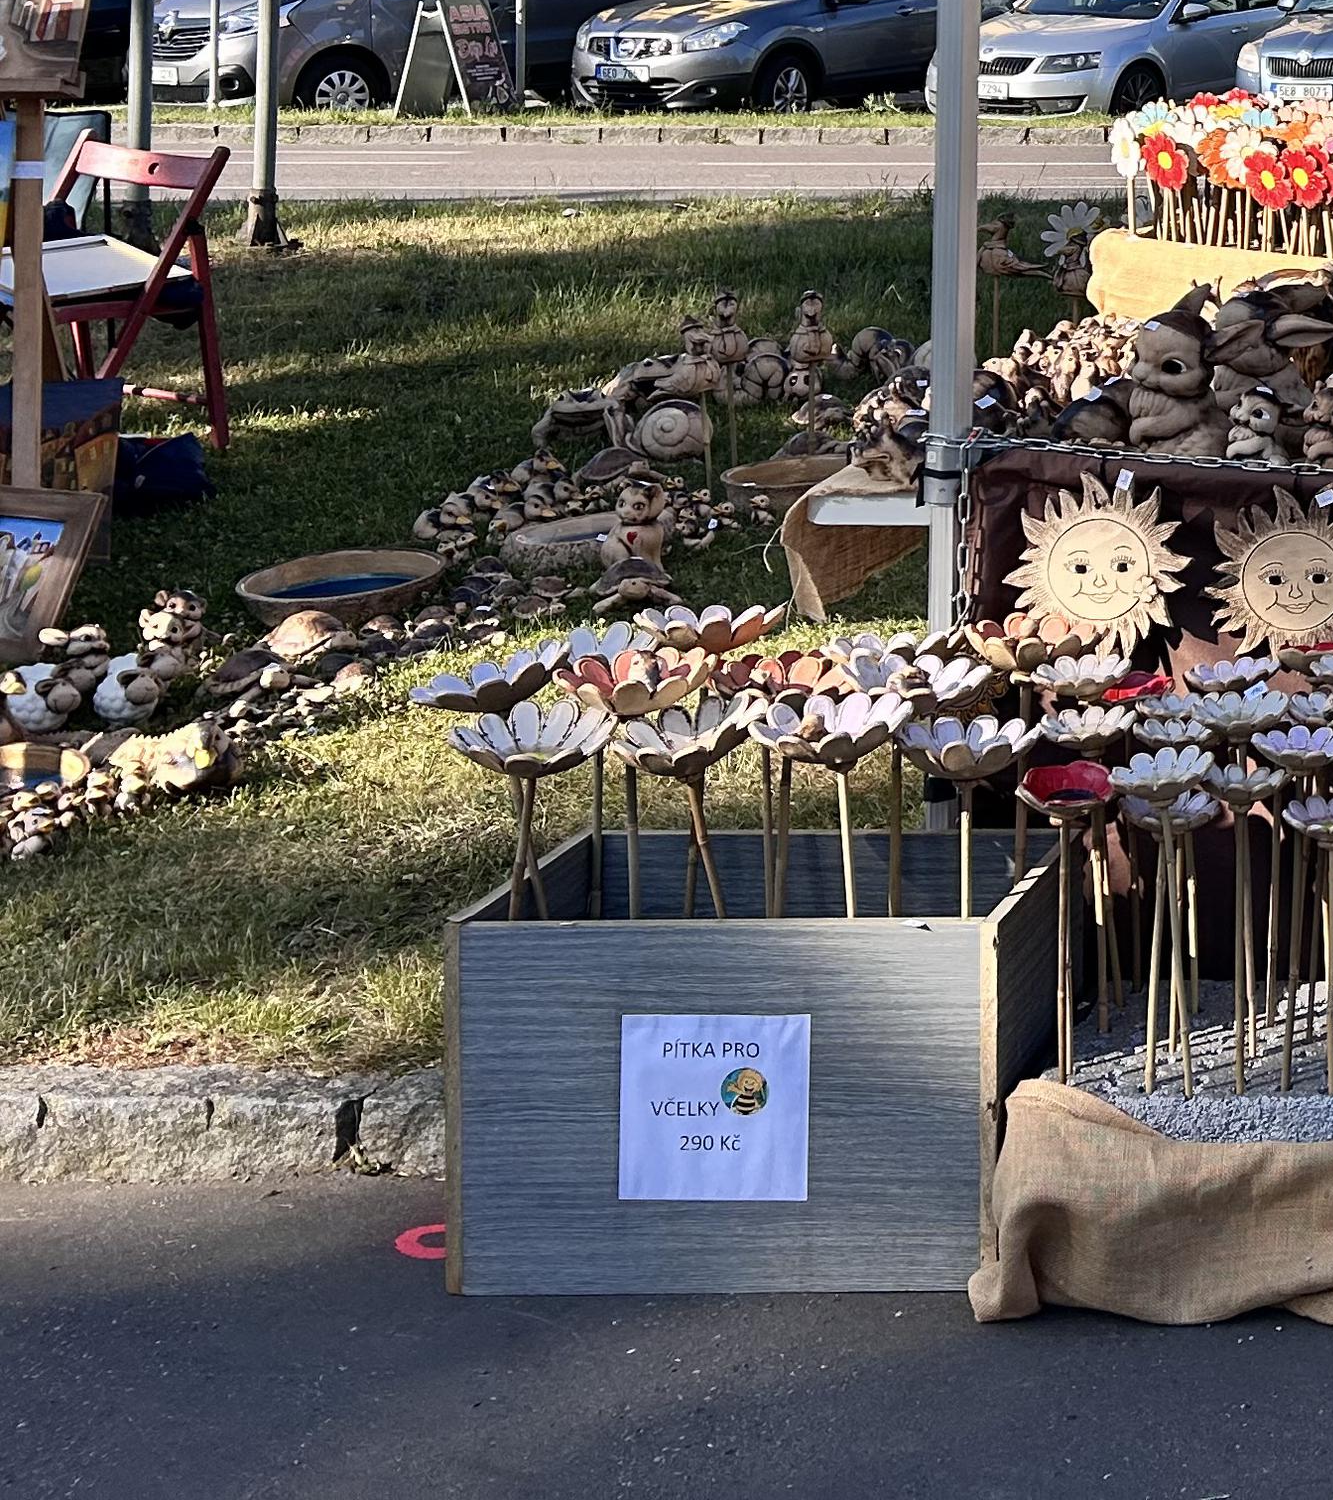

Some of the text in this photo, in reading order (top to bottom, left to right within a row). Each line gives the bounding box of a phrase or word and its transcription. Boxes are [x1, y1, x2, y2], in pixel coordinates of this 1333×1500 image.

[448, 4, 489, 21] ASIA
[662, 1038, 760, 1059] PÍTKA PRO
[650, 1096, 720, 1117] VČELKY
[679, 1134, 741, 1151] 290 Kč
